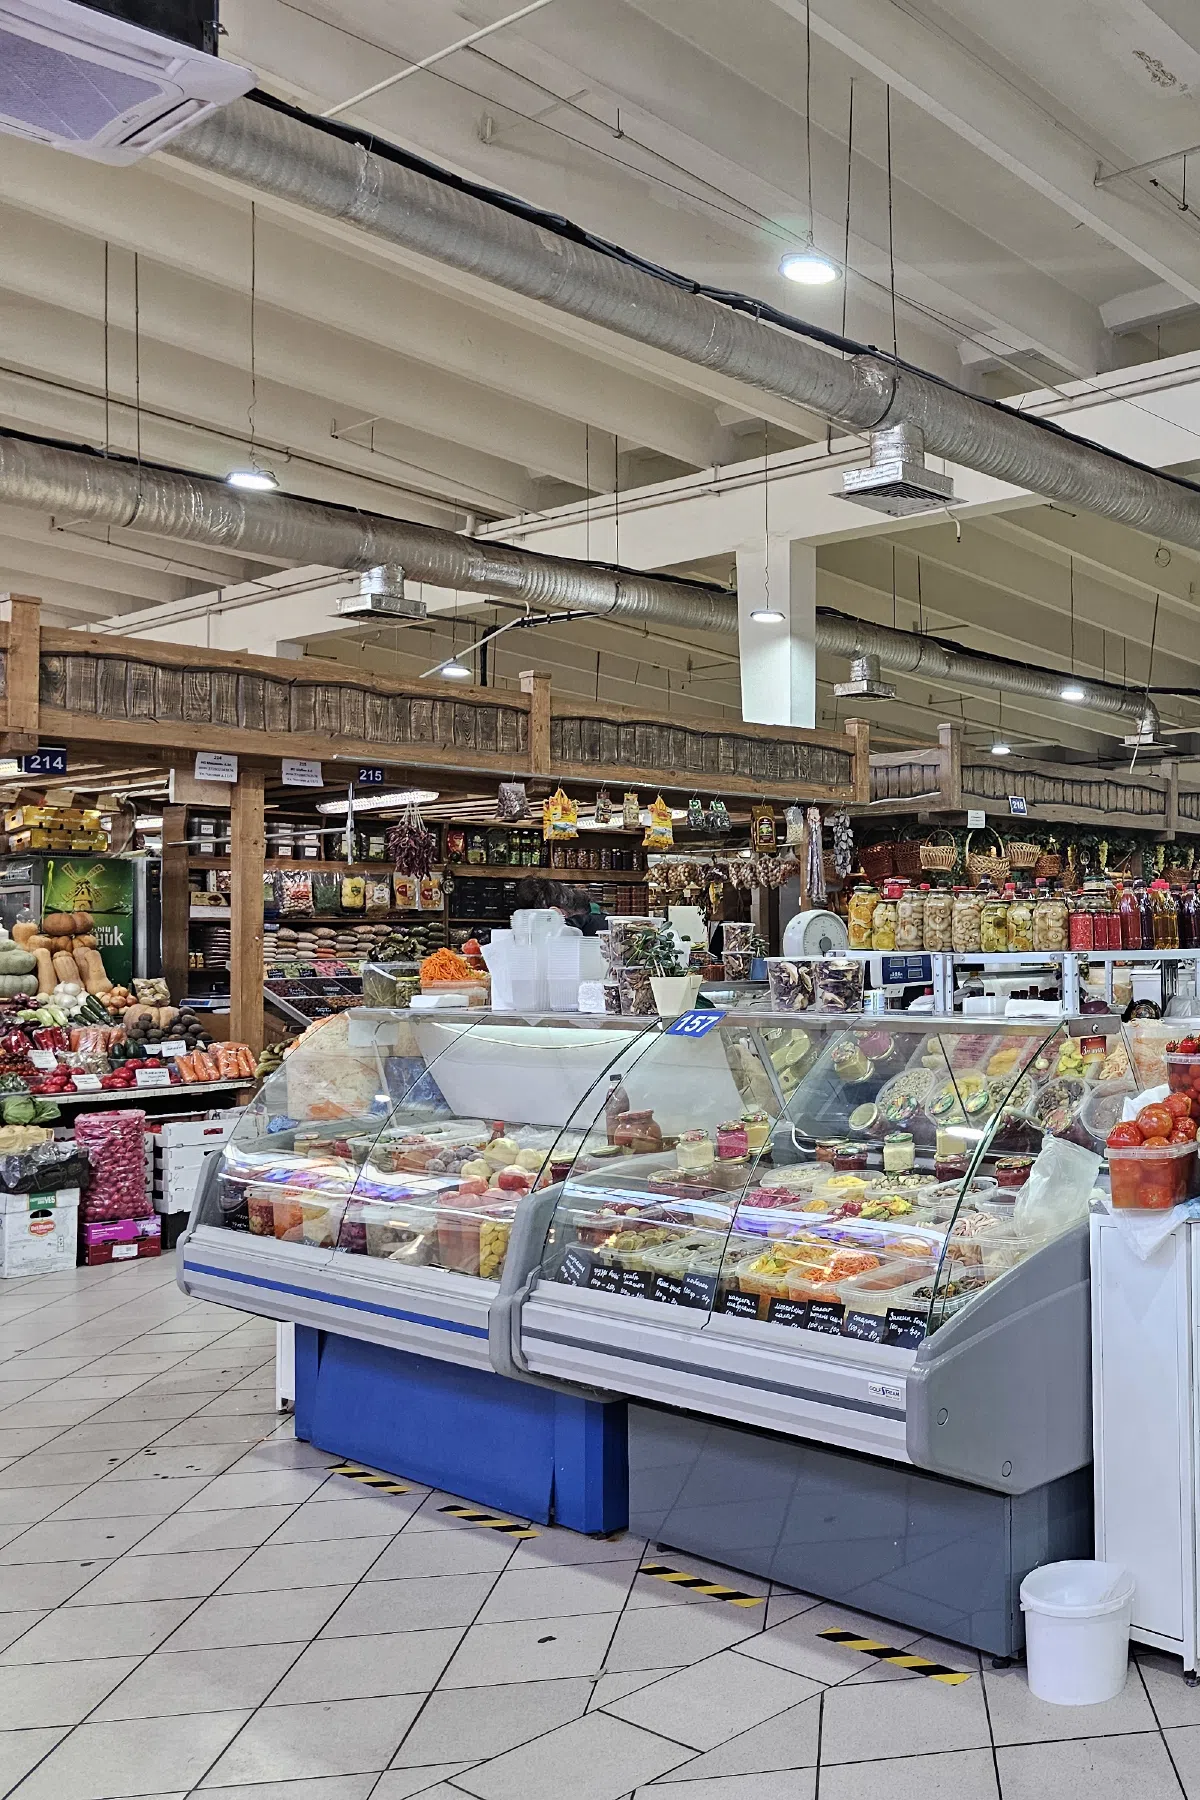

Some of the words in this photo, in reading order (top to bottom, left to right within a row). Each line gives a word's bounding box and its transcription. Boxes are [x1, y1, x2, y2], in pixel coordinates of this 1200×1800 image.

[30, 755, 64, 769] 214
[359, 769, 382, 782] 215
[1012, 801, 1024, 810] 218
[675, 1014, 719, 1033] 157
